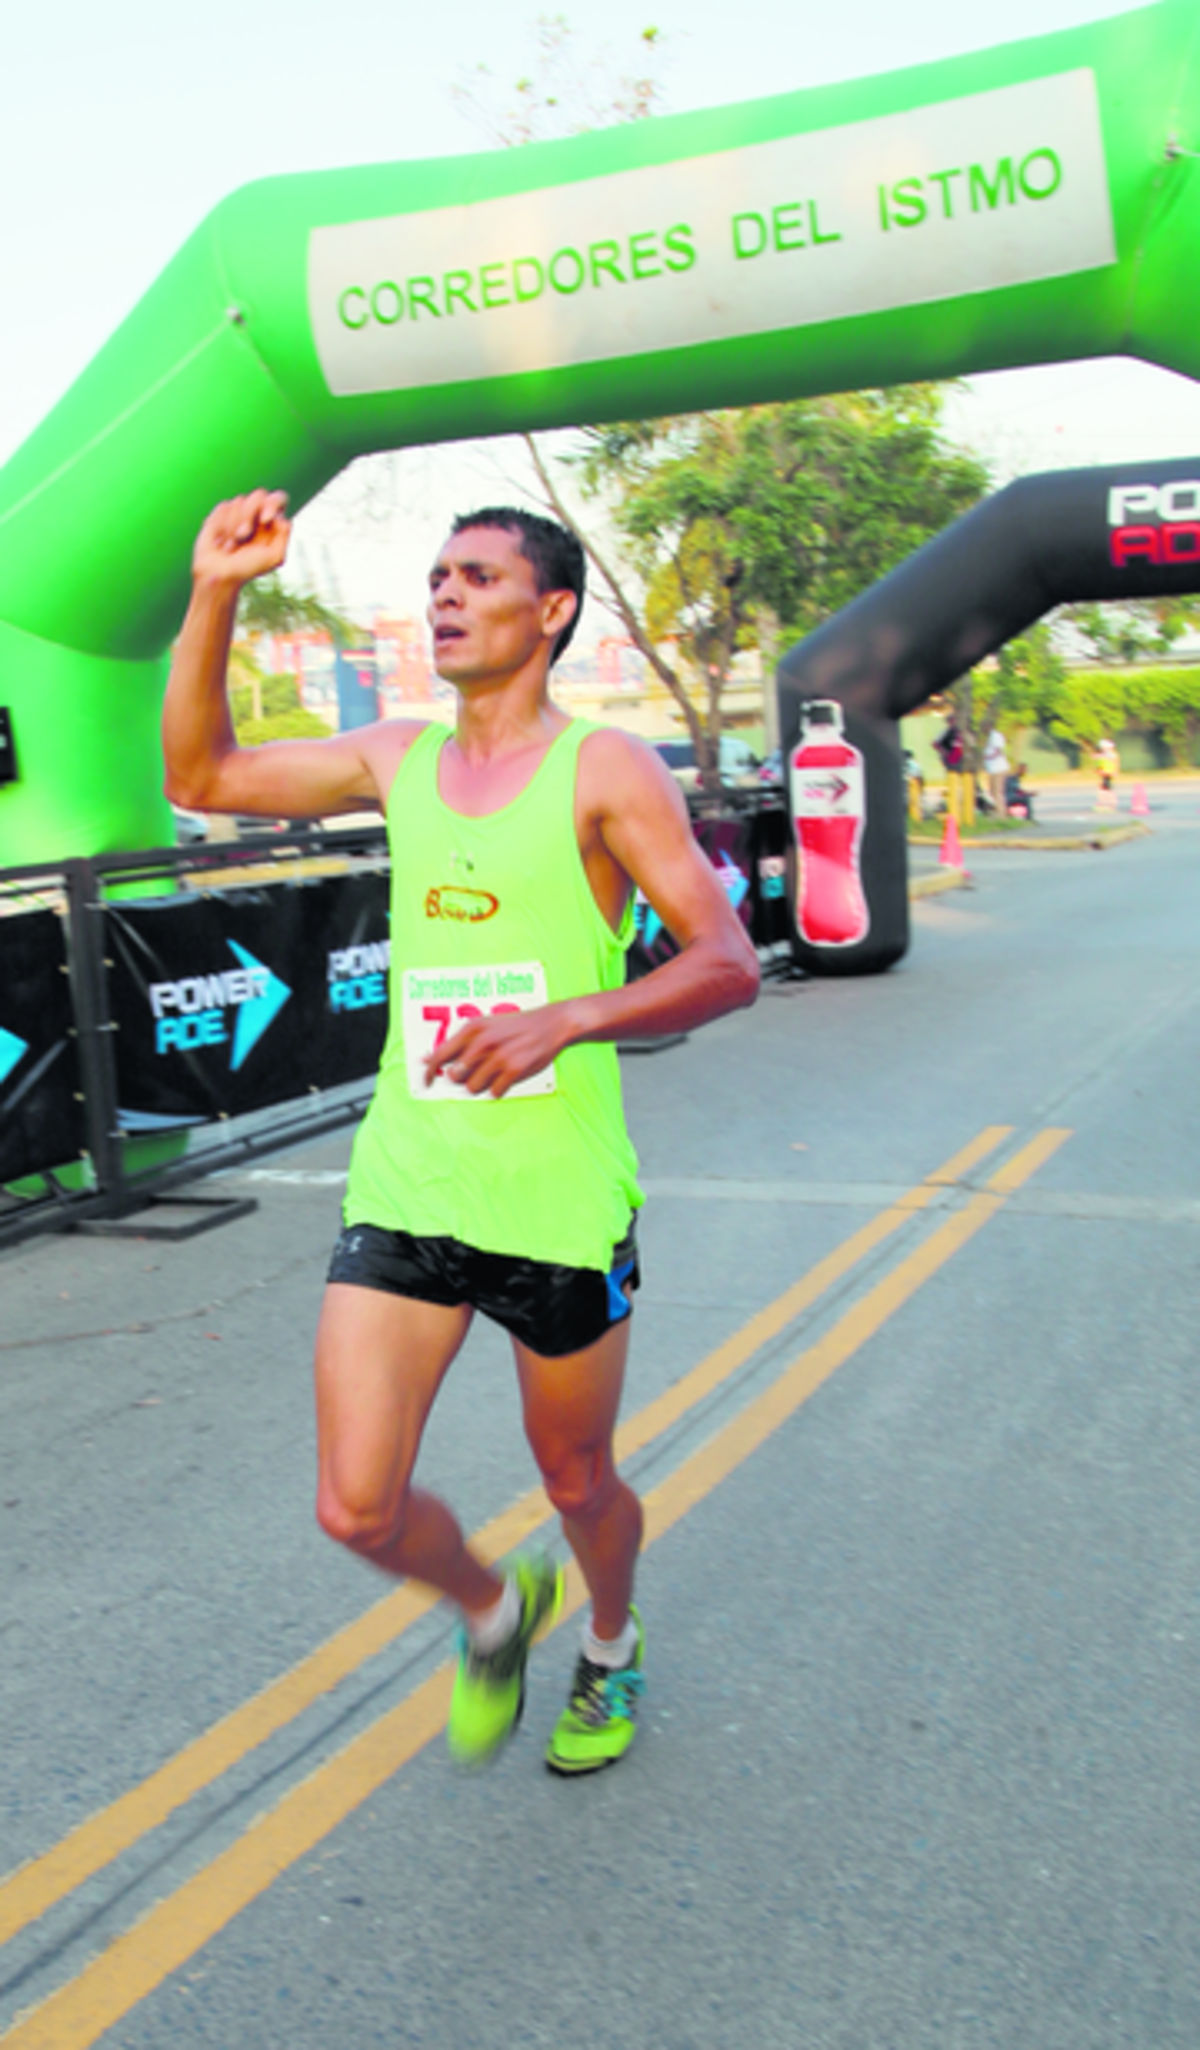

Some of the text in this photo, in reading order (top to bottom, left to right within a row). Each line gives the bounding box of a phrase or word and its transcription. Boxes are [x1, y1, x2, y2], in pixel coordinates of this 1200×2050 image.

[336, 145, 1065, 330] CORREDORES DEL ISTMO
[149, 965, 271, 1019] POWER
[155, 1007, 229, 1055] ADE
